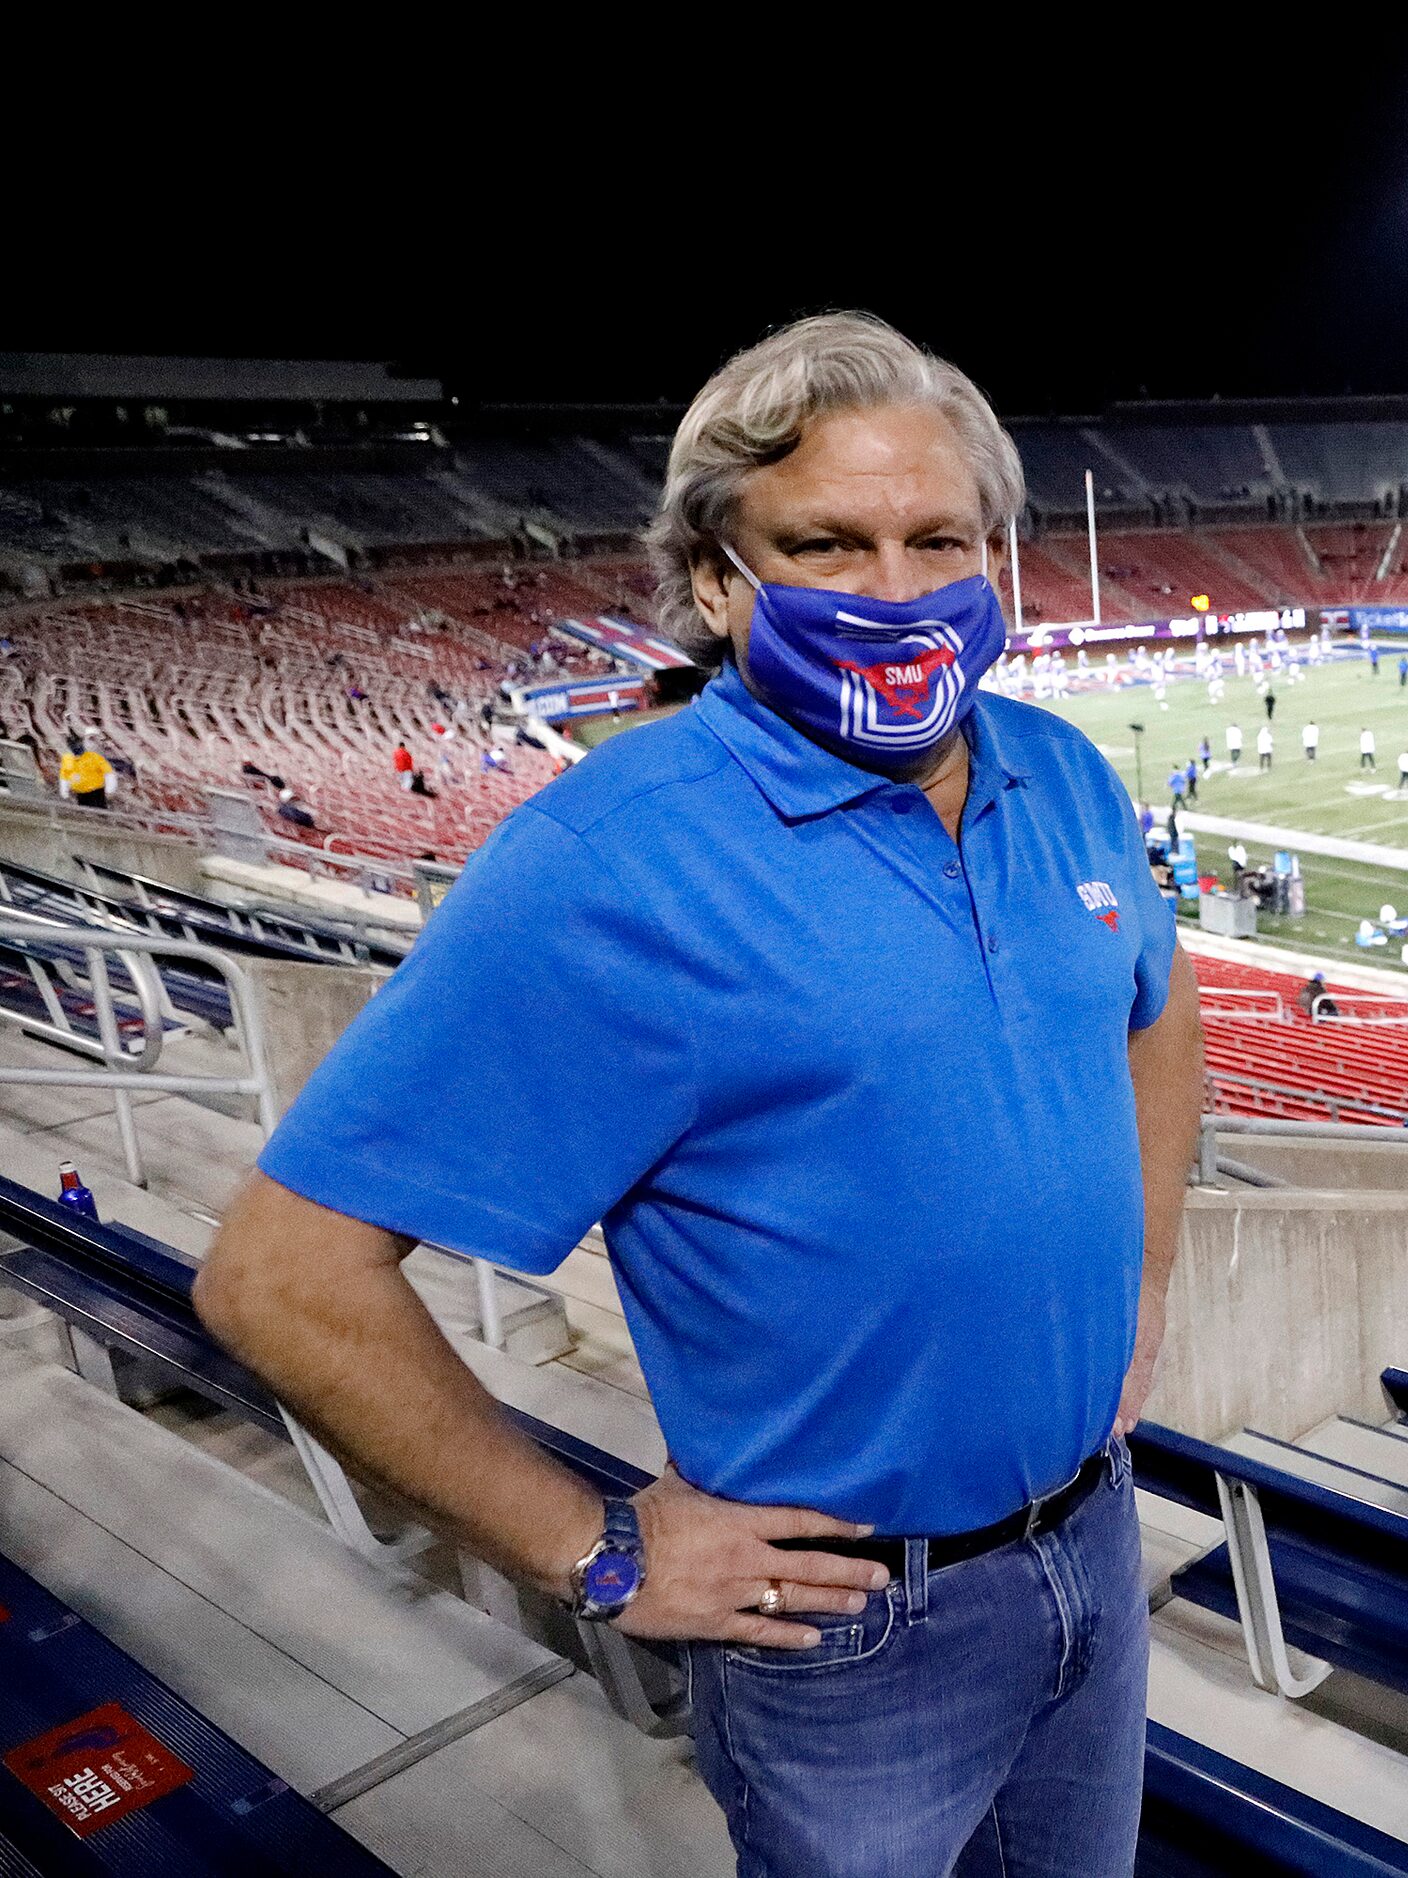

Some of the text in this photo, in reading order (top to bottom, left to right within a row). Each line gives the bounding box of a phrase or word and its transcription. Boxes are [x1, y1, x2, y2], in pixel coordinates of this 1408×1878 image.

[885, 664, 923, 686] SMU
[47, 1783, 92, 1821] PLEASE SIT
[63, 1767, 121, 1813] HERE
